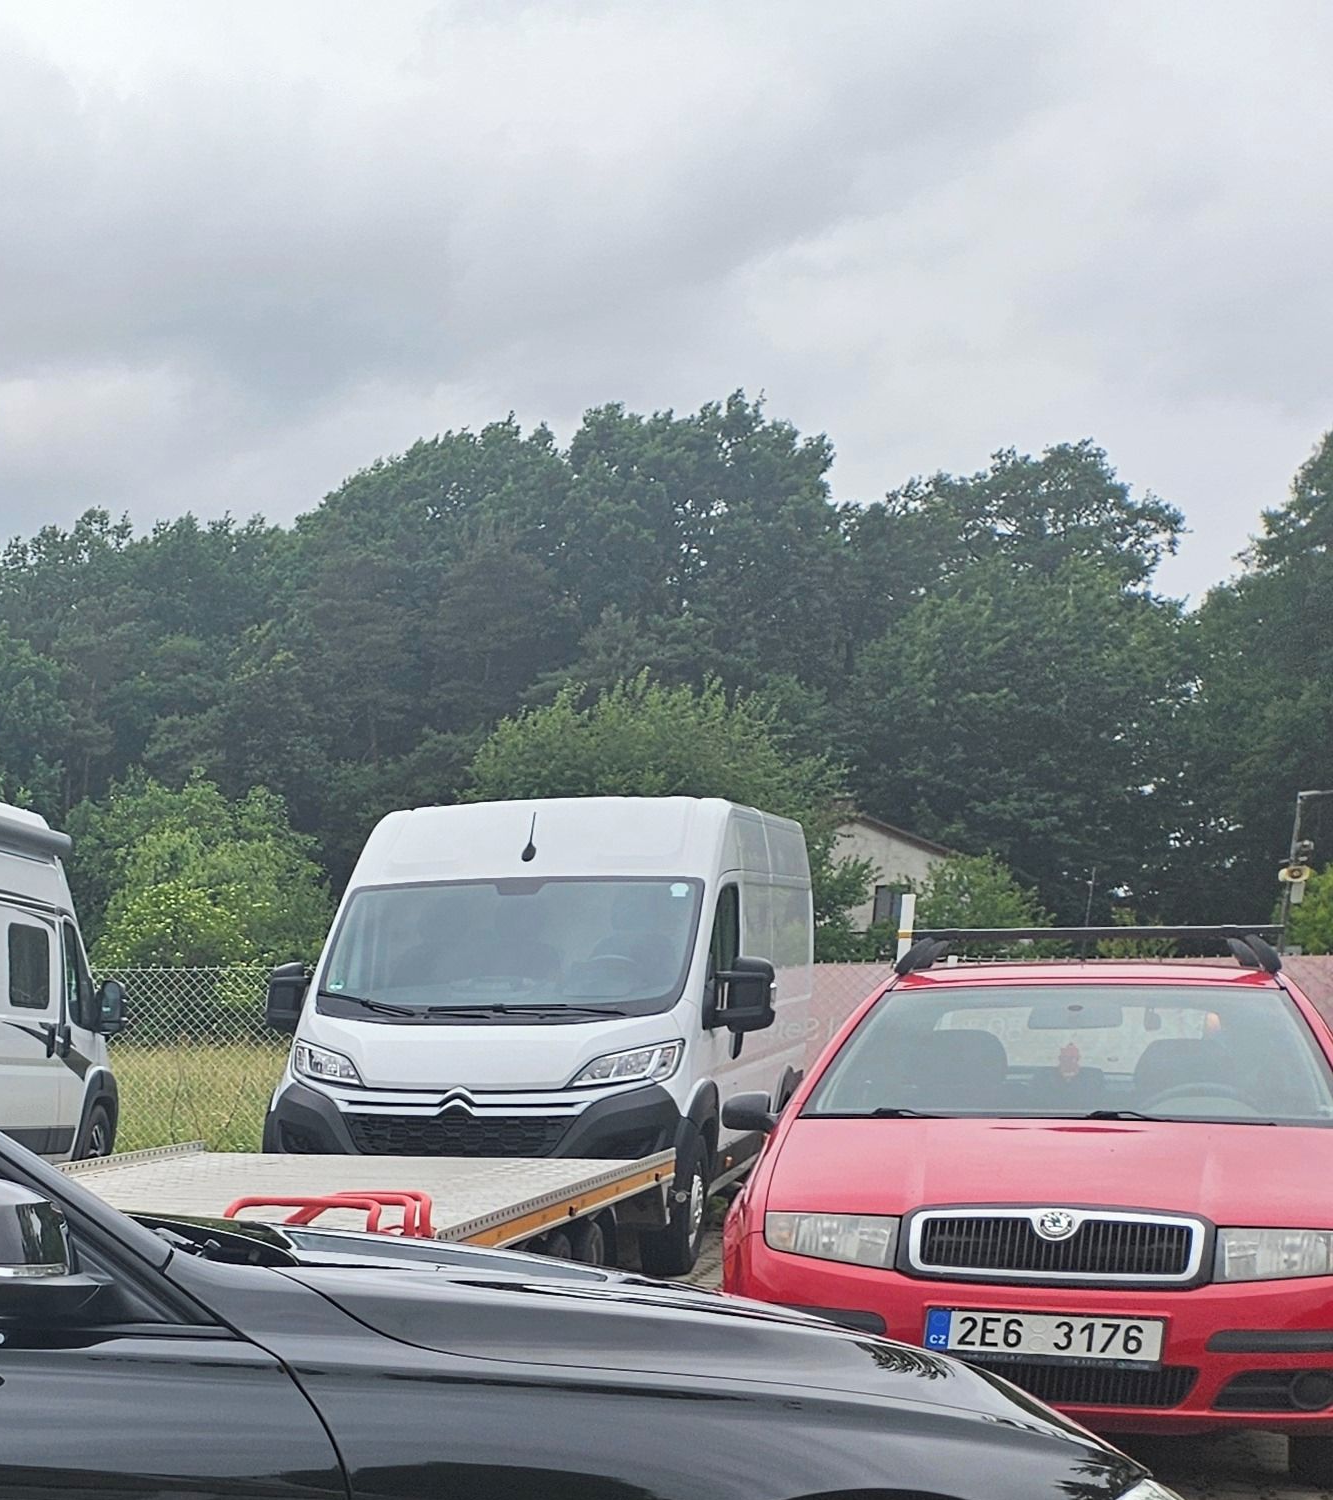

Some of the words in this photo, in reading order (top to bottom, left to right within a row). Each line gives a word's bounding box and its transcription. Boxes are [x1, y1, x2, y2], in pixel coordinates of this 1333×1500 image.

[930, 1335, 946, 1346] CZ
[957, 1316, 1024, 1349] 2E6
[1053, 1321, 1144, 1355] 3176
